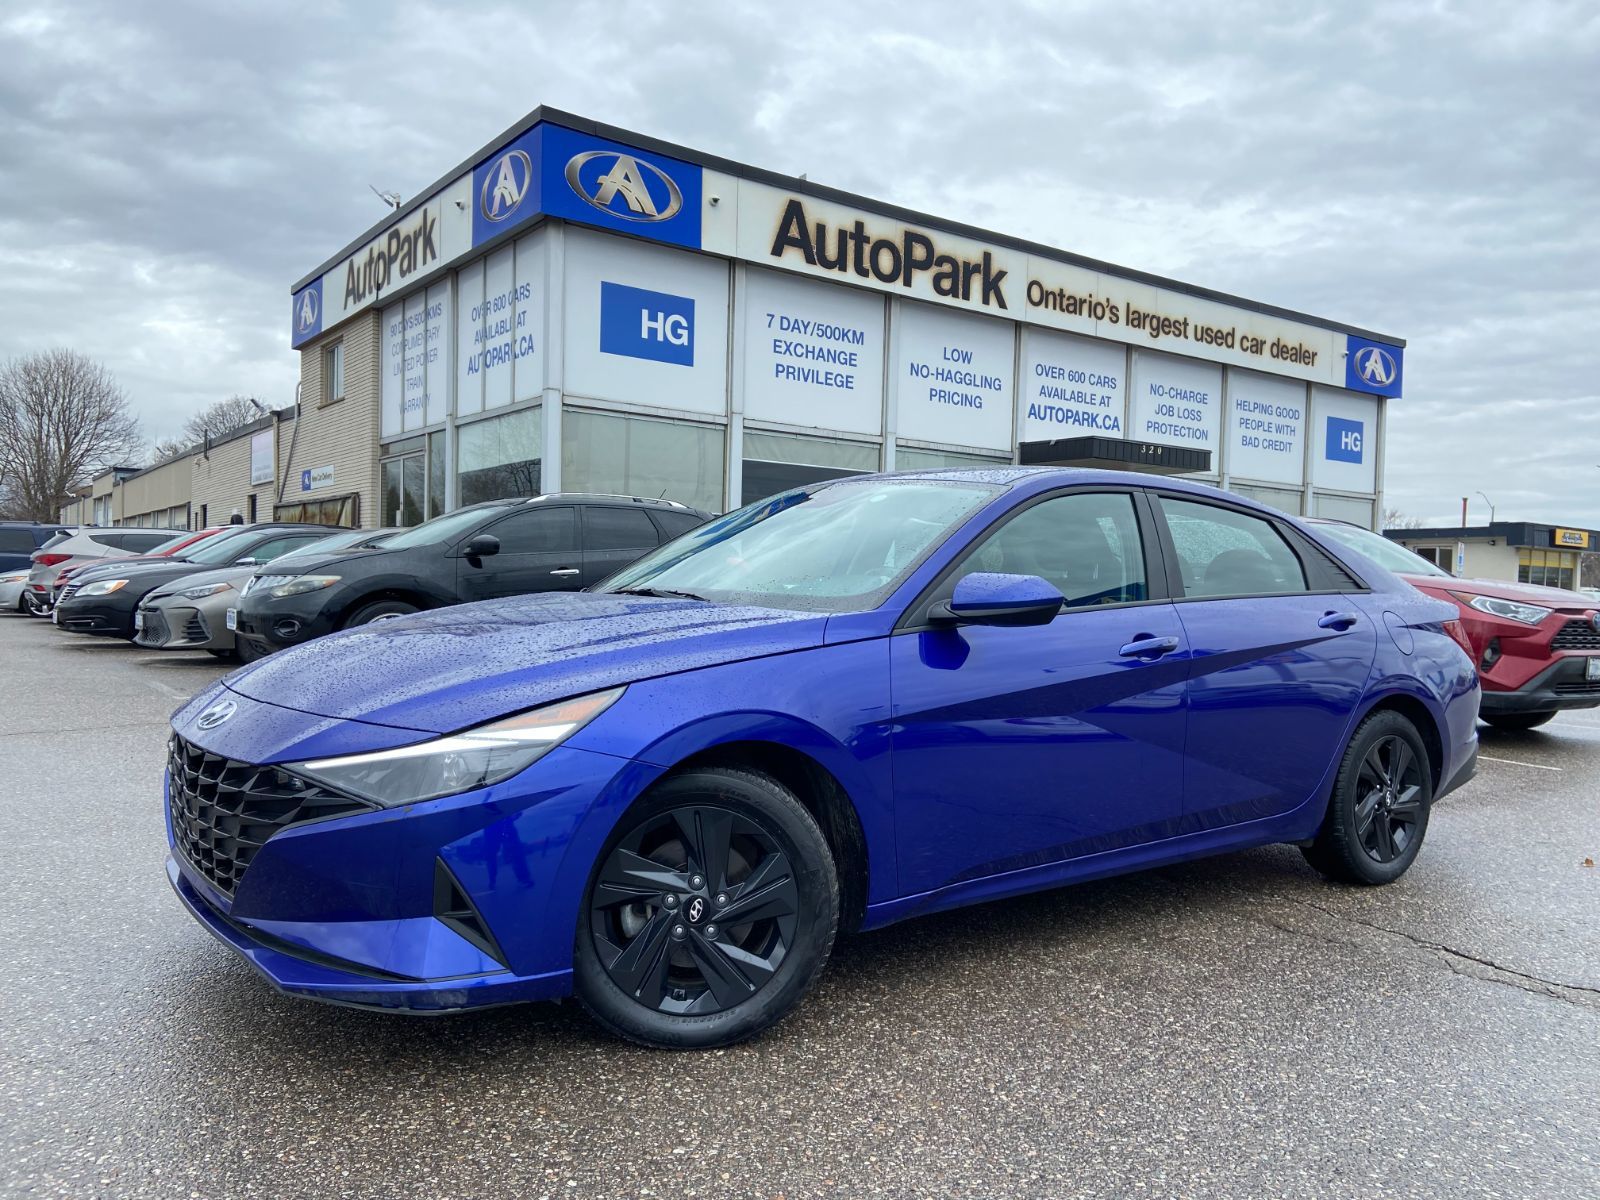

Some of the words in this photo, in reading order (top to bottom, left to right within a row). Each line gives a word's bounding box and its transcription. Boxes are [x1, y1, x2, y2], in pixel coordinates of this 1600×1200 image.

[344, 208, 437, 310] AutoPark
[770, 199, 1008, 310] AutoPark
[493, 294, 506, 312] 600
[517, 310, 527, 328] AT
[641, 308, 689, 346] HG
[766, 313, 775, 328] 7
[779, 315, 865, 346] DAY/500KM
[1026, 280, 1120, 324] Ontario's
[1125, 302, 1189, 340] largest
[1194, 324, 1235, 349] used
[1240, 334, 1266, 355] car
[1270, 338, 1317, 367] dealer
[773, 338, 858, 367] EXCHANGE
[943, 346, 973, 365] LOW
[775, 363, 854, 390] PRIVILEGE
[910, 362, 1002, 392] NO-HAGGLING
[1035, 363, 1065, 381] OVER
[1068, 370, 1086, 384] 600
[1088, 374, 1117, 390] CARS
[929, 387, 983, 409] PRICING
[1039, 385, 1096, 406] AVAILABLE
[1099, 394, 1112, 408] AT
[1150, 383, 1208, 405] NO-CHARGE
[1028, 403, 1120, 431] AUTOPARK.CA
[1154, 404, 1175, 418] JOB
[1177, 407, 1202, 422] LOSS
[1236, 399, 1273, 416] HELPING
[1275, 405, 1300, 421] GOOD
[1146, 420, 1208, 441] PROTECTION
[1239, 417, 1273, 434] PEOPLE
[1275, 423, 1296, 437] WITH
[1241, 435, 1260, 449] BAD
[1261, 438, 1293, 453] CREDIT
[1341, 430, 1361, 452] HG
